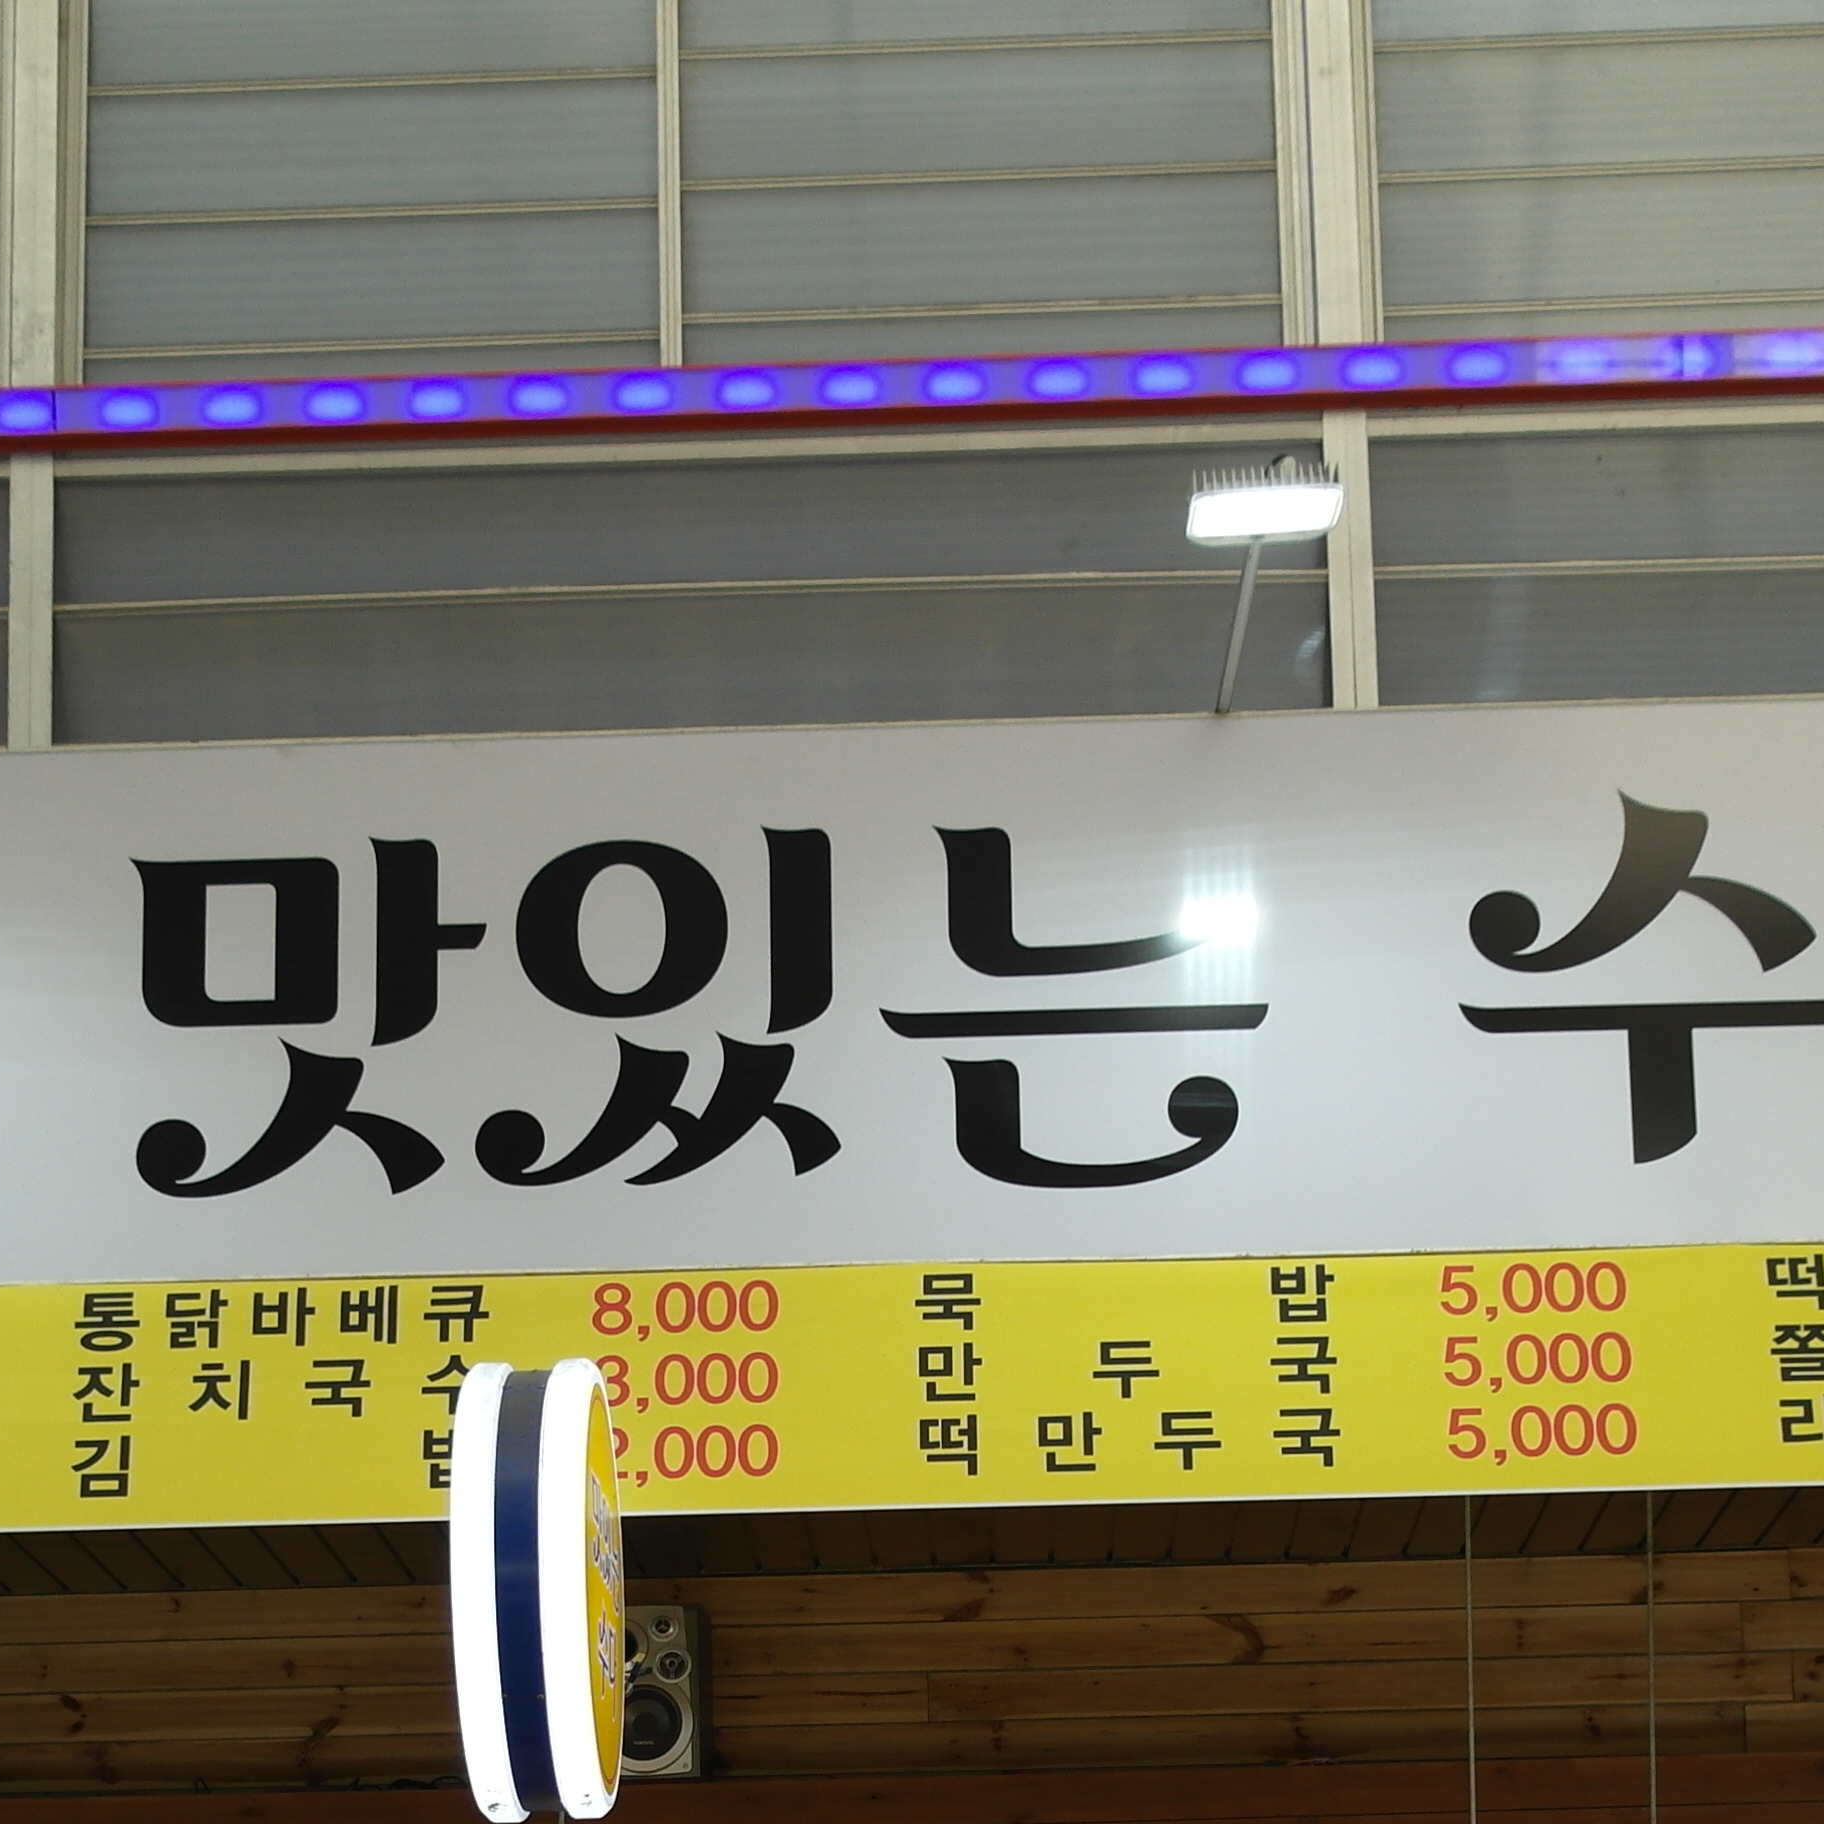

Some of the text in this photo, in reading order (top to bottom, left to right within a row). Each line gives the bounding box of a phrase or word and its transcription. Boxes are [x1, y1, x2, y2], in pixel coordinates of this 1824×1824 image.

[132, 828, 1269, 1198] 맛있는
[76, 1279, 779, 1352] 통닭바베큐 8,000
[1439, 1260, 1628, 1322] 5,000
[600, 1352, 779, 1414] 3,000
[1443, 1331, 1633, 1393] 5,000
[921, 1402, 1638, 1476] 떡만두국 5,000
